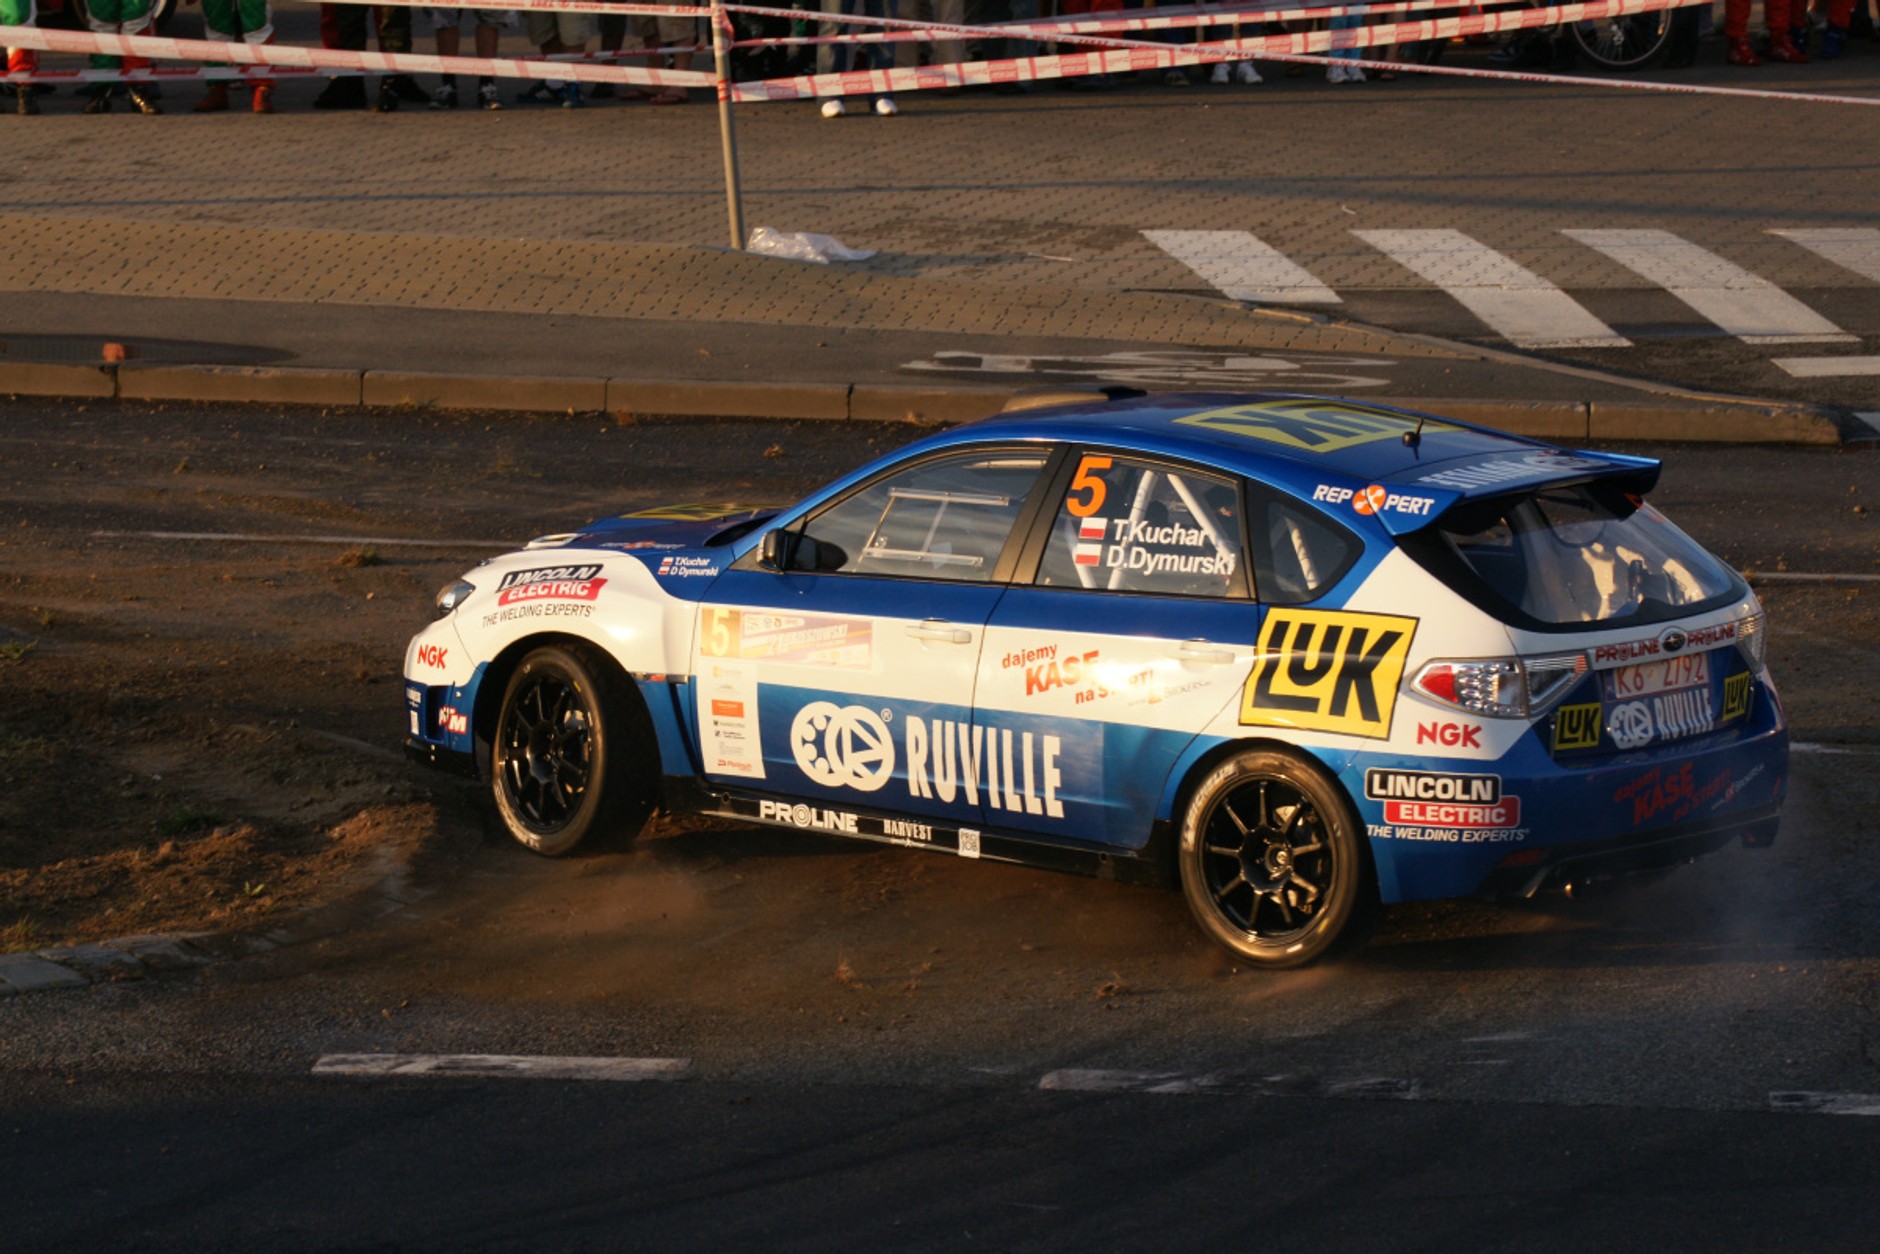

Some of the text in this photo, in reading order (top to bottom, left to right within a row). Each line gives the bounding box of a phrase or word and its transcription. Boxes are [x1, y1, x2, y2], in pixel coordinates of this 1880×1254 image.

[1066, 456, 1114, 518] 5
[1113, 518, 1208, 547] T.Kuchar
[1106, 545, 1236, 576] D.Dymurski
[500, 567, 597, 591] LINCOLN
[508, 581, 592, 601] ELECTRIC
[482, 611, 499, 628] THE
[499, 604, 544, 623] WELDING
[710, 607, 730, 657] 5
[416, 643, 449, 670] NGK
[1001, 643, 1058, 669] dajemy
[1595, 639, 1660, 663] PROLINE
[1251, 619, 1405, 724] LUK
[1075, 686, 1095, 704] na
[1725, 677, 1747, 715] LUK
[1557, 707, 1600, 745] LUK
[1653, 688, 1714, 741] RUVILLE
[1416, 721, 1483, 749] NGK
[904, 714, 1065, 819] RUVILLE
[1372, 773, 1493, 801] LINCOLN
[759, 800, 859, 834] PROLINE
[1399, 803, 1506, 824] ELECTRIC
[883, 819, 933, 841] HARVEST
[1366, 825, 1526, 844] THE WELDING EXPERTS
